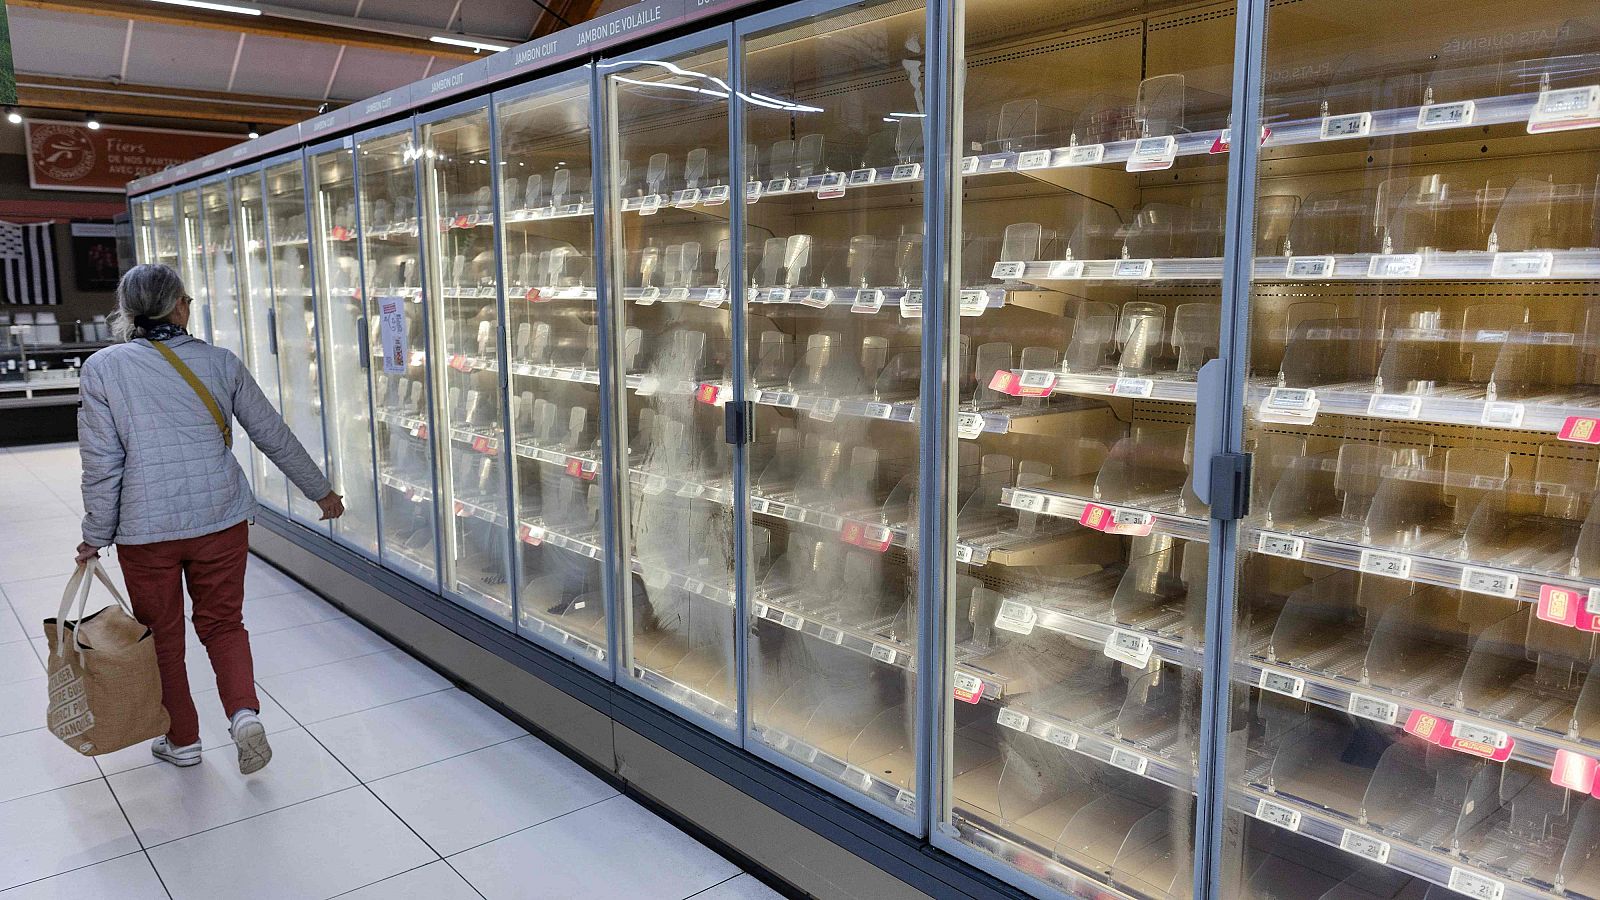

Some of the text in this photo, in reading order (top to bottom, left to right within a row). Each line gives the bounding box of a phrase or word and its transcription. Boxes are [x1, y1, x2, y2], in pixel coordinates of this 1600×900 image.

[576, 6, 661, 47] JAMBON DE VOLAILLE
[515, 41, 557, 65] JAMBON CUIT
[431, 73, 464, 93] JAMBON CUIT
[106, 138, 145, 154] Fiers
